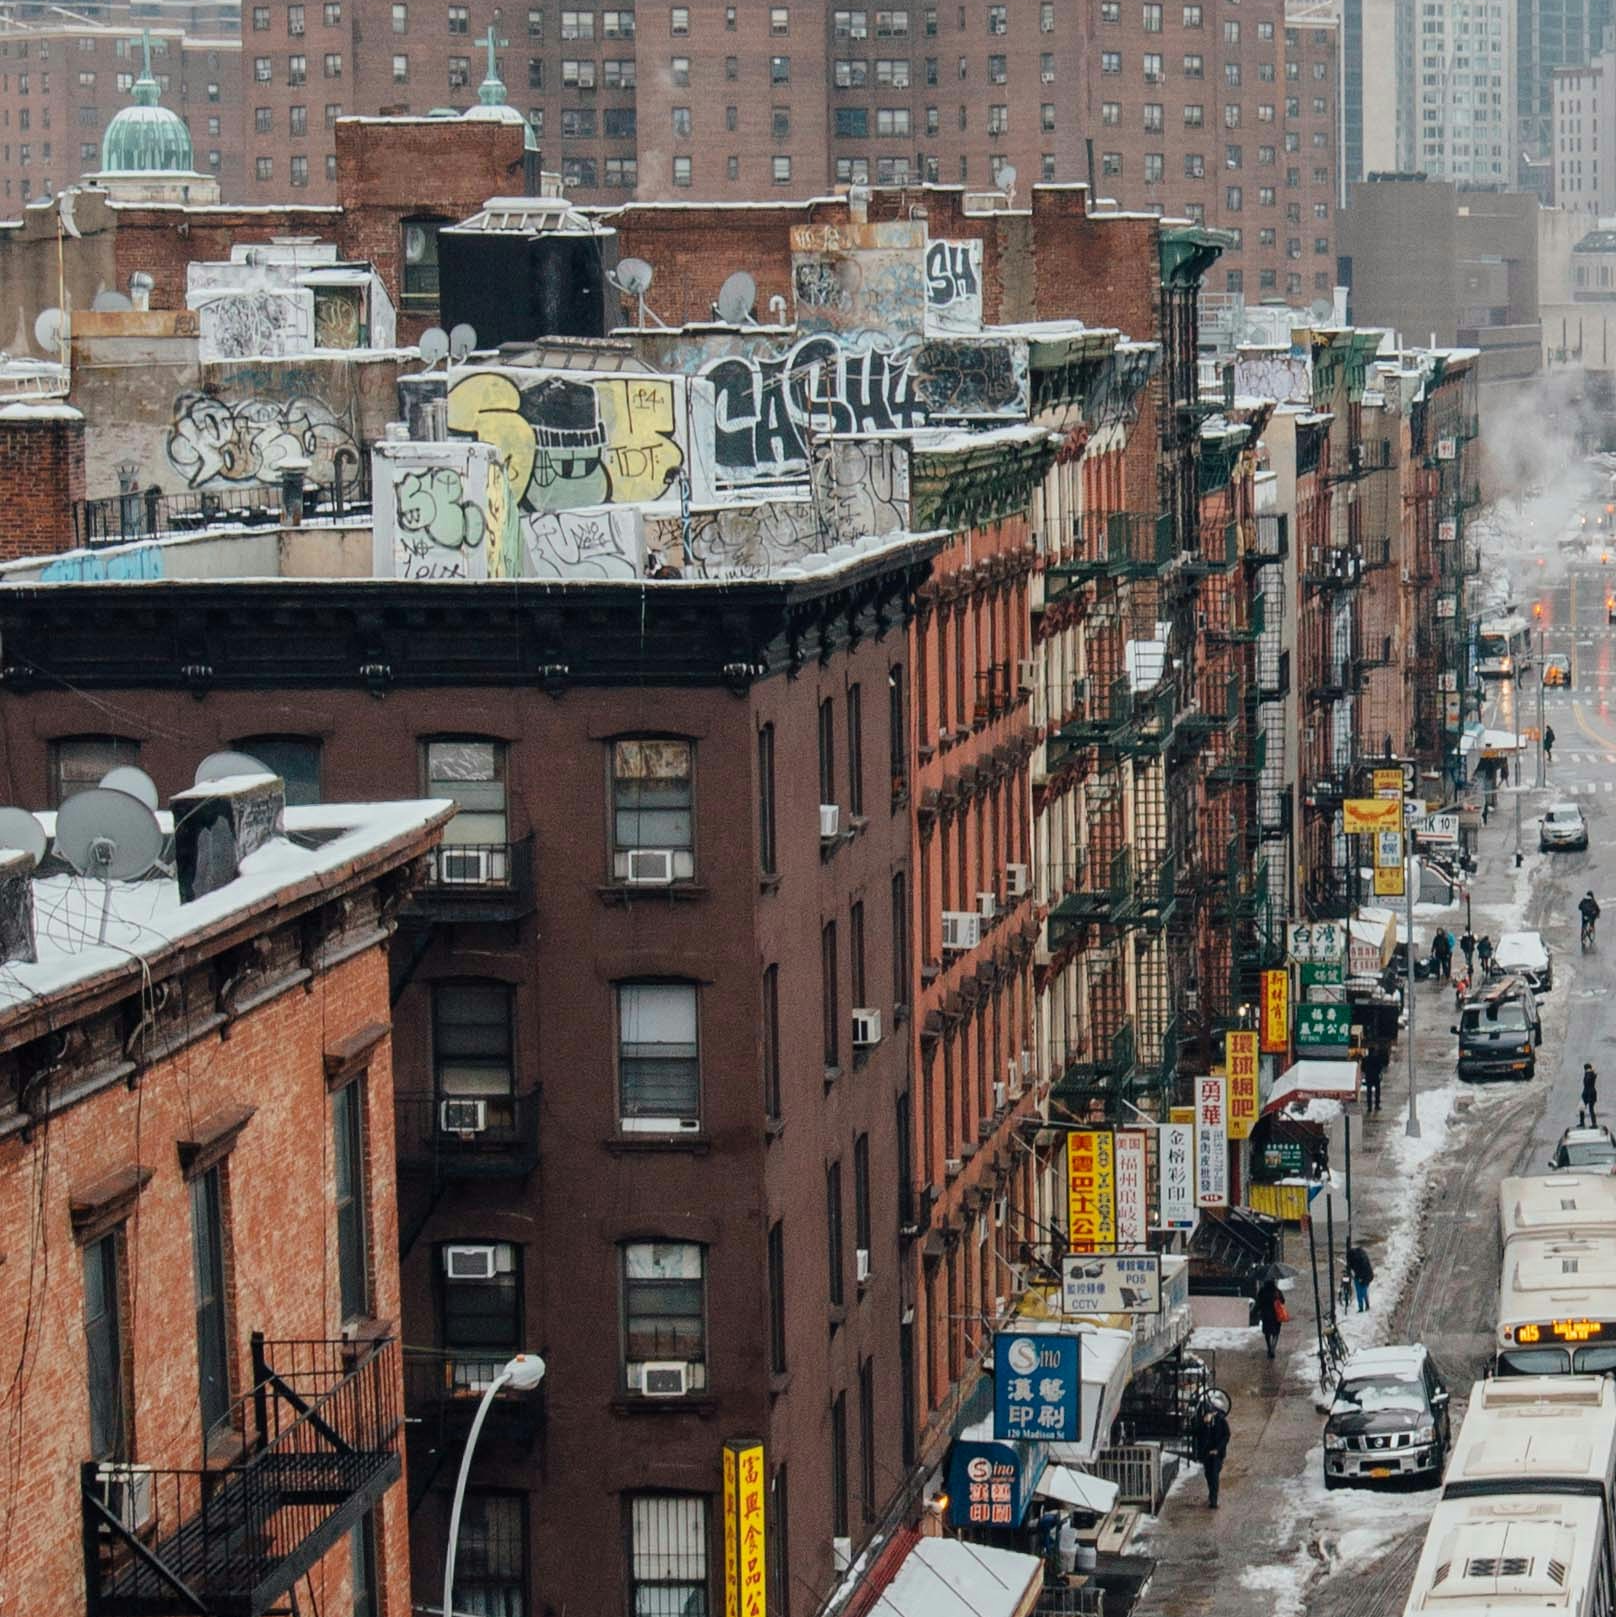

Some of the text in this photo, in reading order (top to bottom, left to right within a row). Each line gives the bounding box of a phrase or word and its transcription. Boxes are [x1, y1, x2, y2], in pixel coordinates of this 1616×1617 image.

[1231, 1034, 1254, 1118] 環球網吧
[1201, 1080, 1222, 1126] 勇華
[1126, 1274, 1147, 1284] POS
[1072, 1299, 1098, 1310] CCTV
[1010, 1339, 1061, 1373] Sino
[1008, 1405, 1065, 1429] 印刷
[1008, 1429, 1065, 1439] 120 Madison St
[970, 1459, 1014, 1479] Sino
